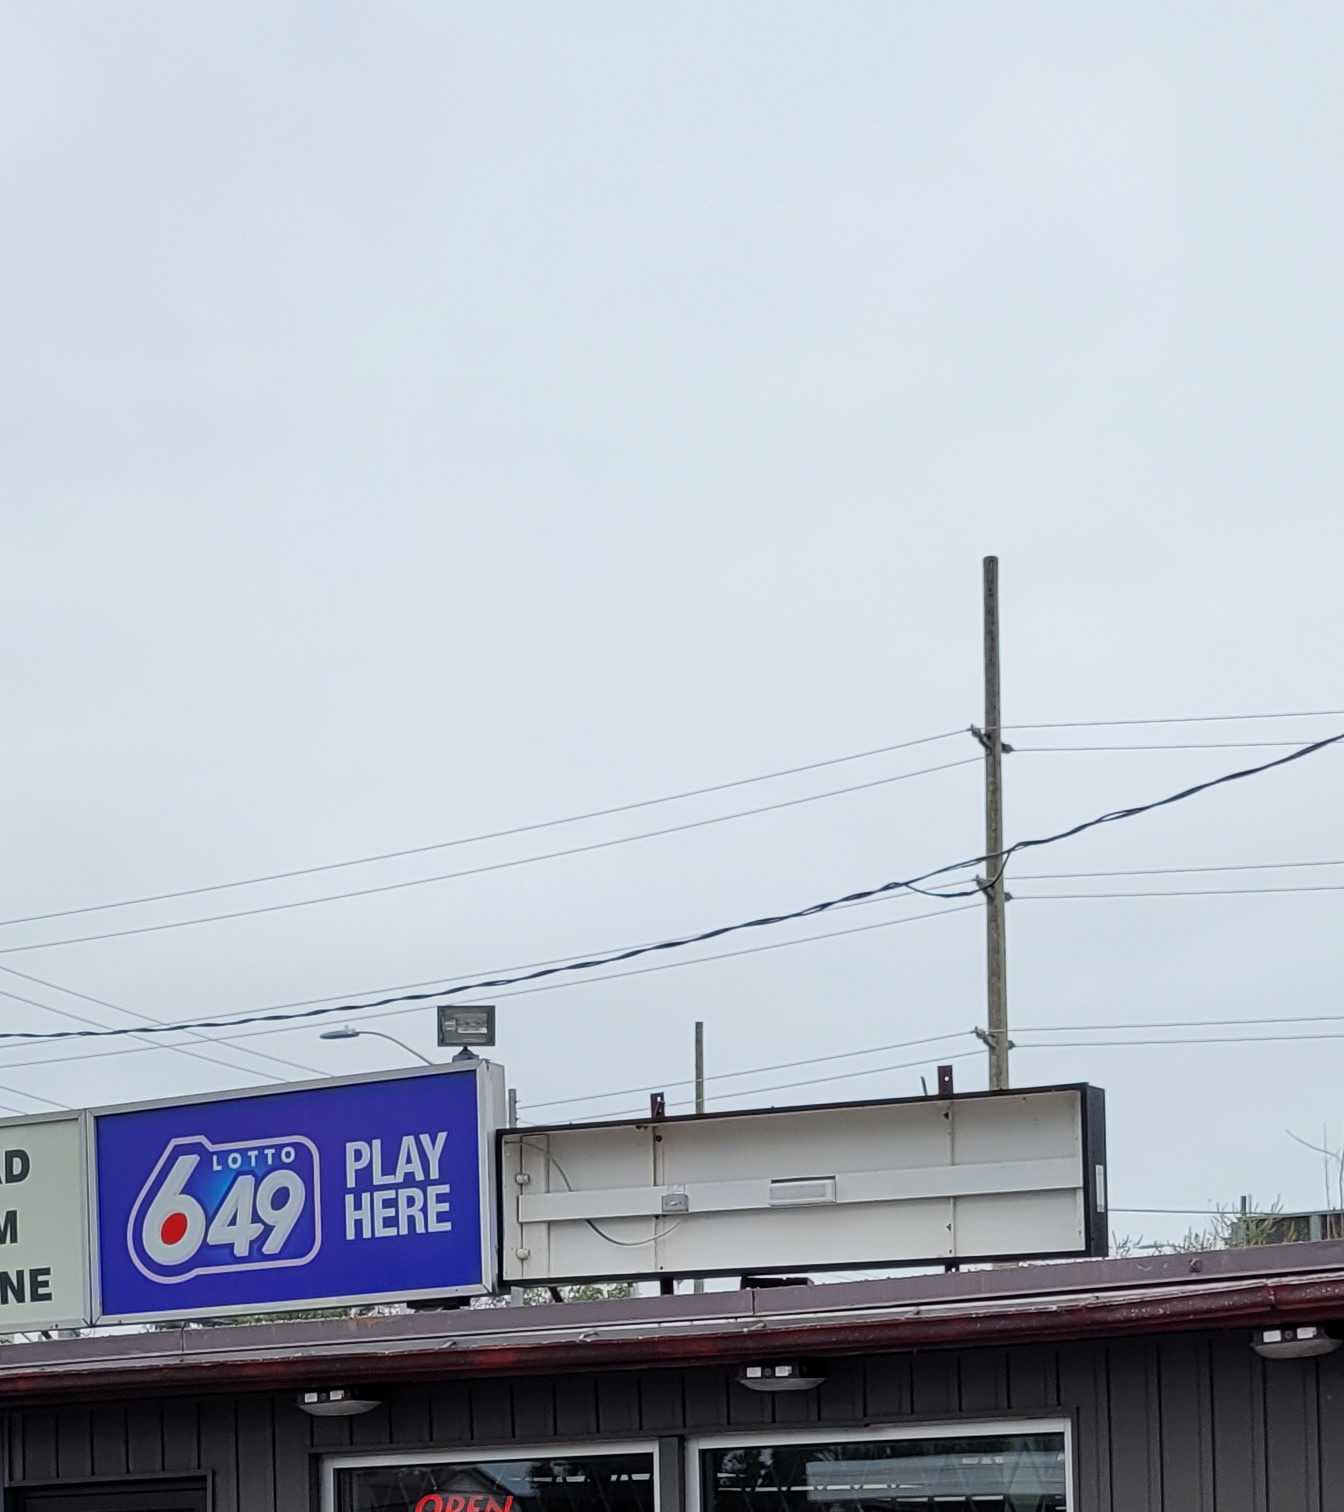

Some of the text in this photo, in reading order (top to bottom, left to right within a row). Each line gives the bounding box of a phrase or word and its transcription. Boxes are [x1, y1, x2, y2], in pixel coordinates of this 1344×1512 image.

[211, 1145, 297, 1172] LOTTO
[344, 1131, 448, 1185] PLAY
[344, 1184, 451, 1241] HERE
